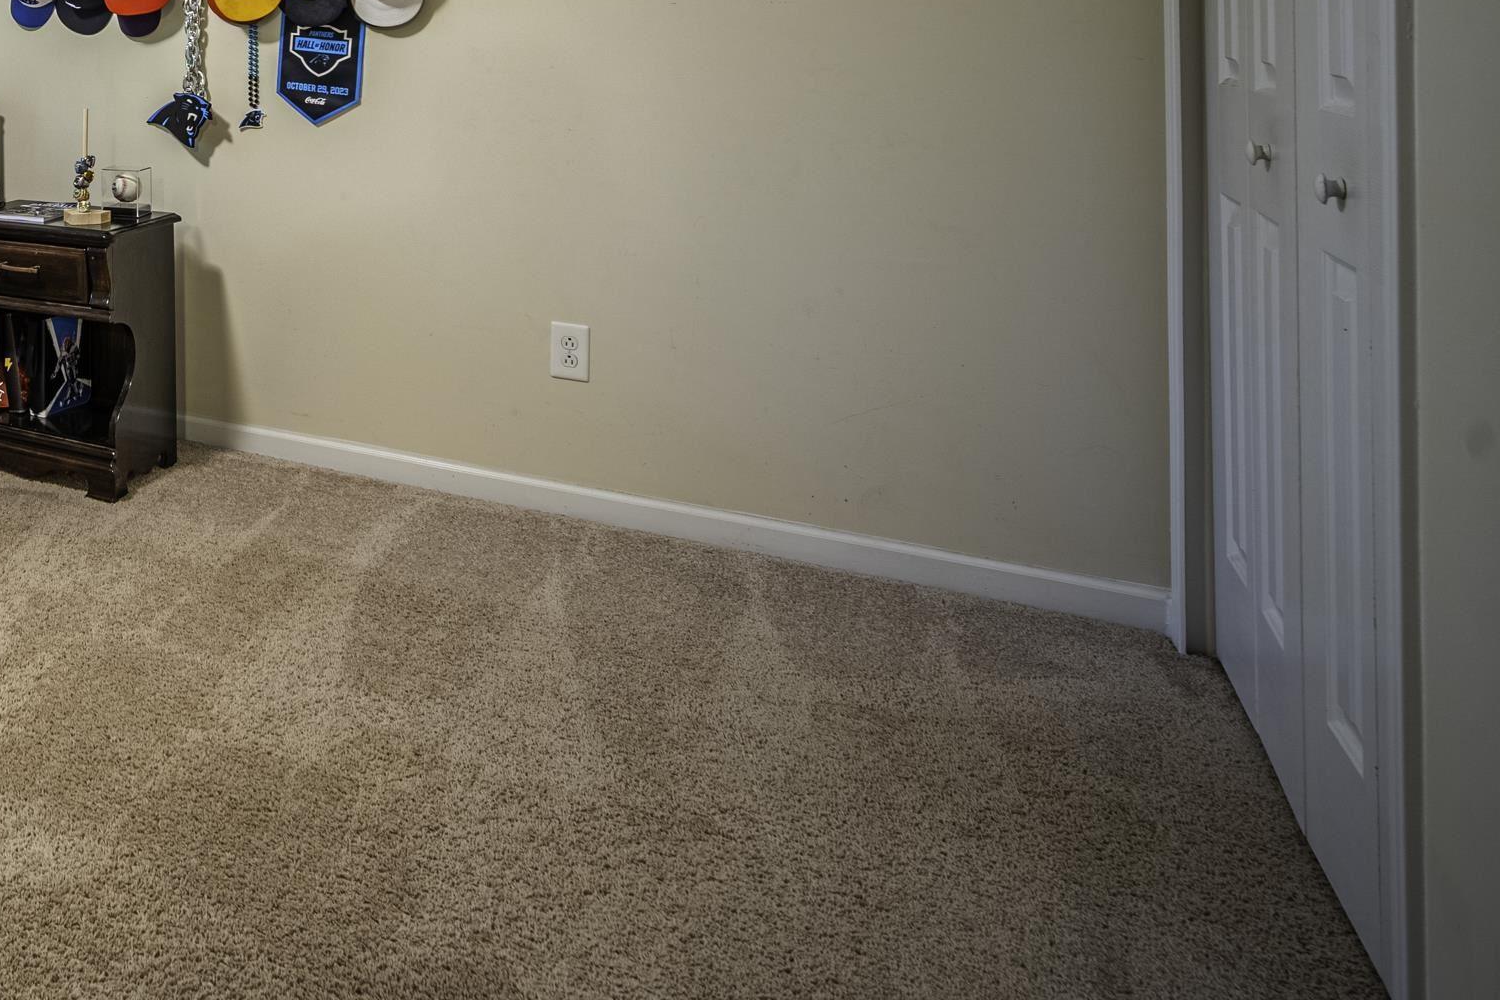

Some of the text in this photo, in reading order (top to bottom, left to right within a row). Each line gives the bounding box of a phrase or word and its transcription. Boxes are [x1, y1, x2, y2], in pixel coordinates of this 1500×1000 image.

[308, 30, 334, 38] PANTHERS
[297, 39, 315, 50] HALL
[319, 42, 346, 53] HONOR
[286, 82, 349, 96] OCTOBER 29, 2023
